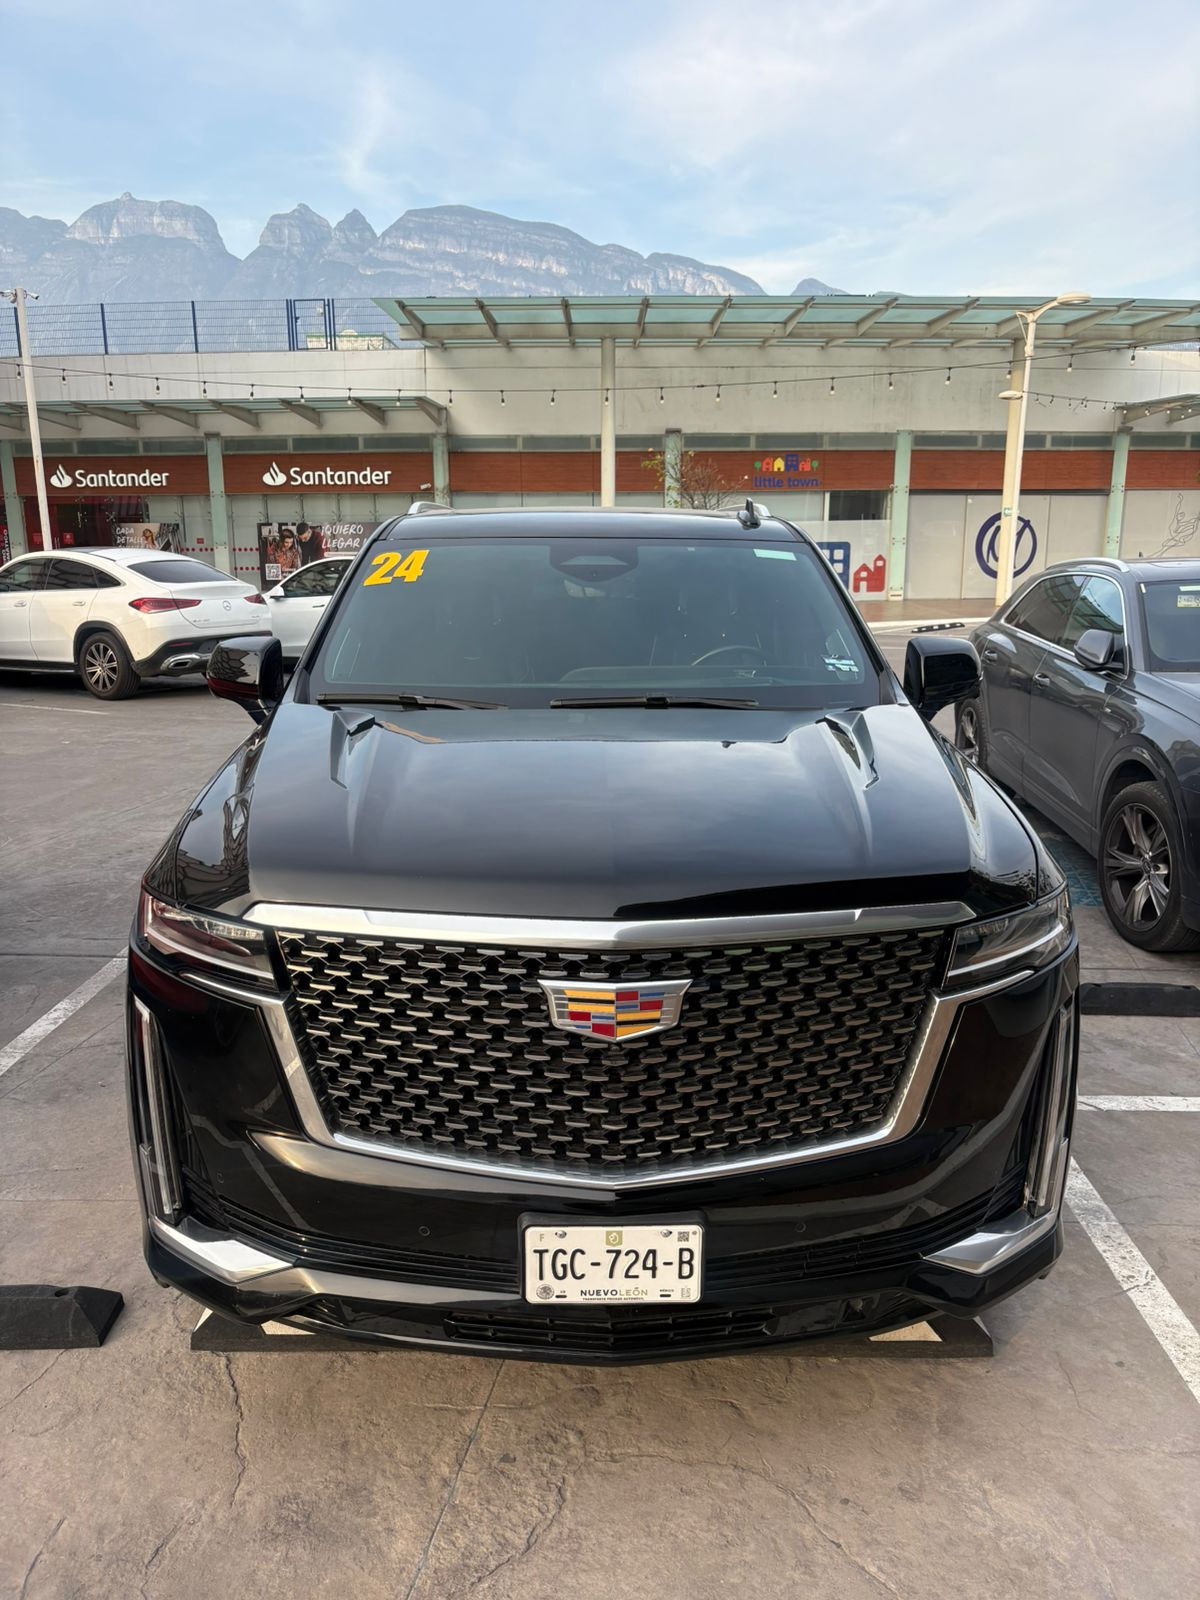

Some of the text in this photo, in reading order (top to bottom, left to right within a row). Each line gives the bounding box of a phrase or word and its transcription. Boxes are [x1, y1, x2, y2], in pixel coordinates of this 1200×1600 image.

[75, 469, 170, 487] Santander
[290, 467, 392, 485] Santander
[754, 476, 819, 488] little town
[116, 527, 135, 535] CADA
[321, 524, 364, 537] ¡QUIERO
[322, 538, 360, 549] LLEGAR
[363, 549, 430, 587] 24
[532, 1247, 694, 1281] TGC-724-B
